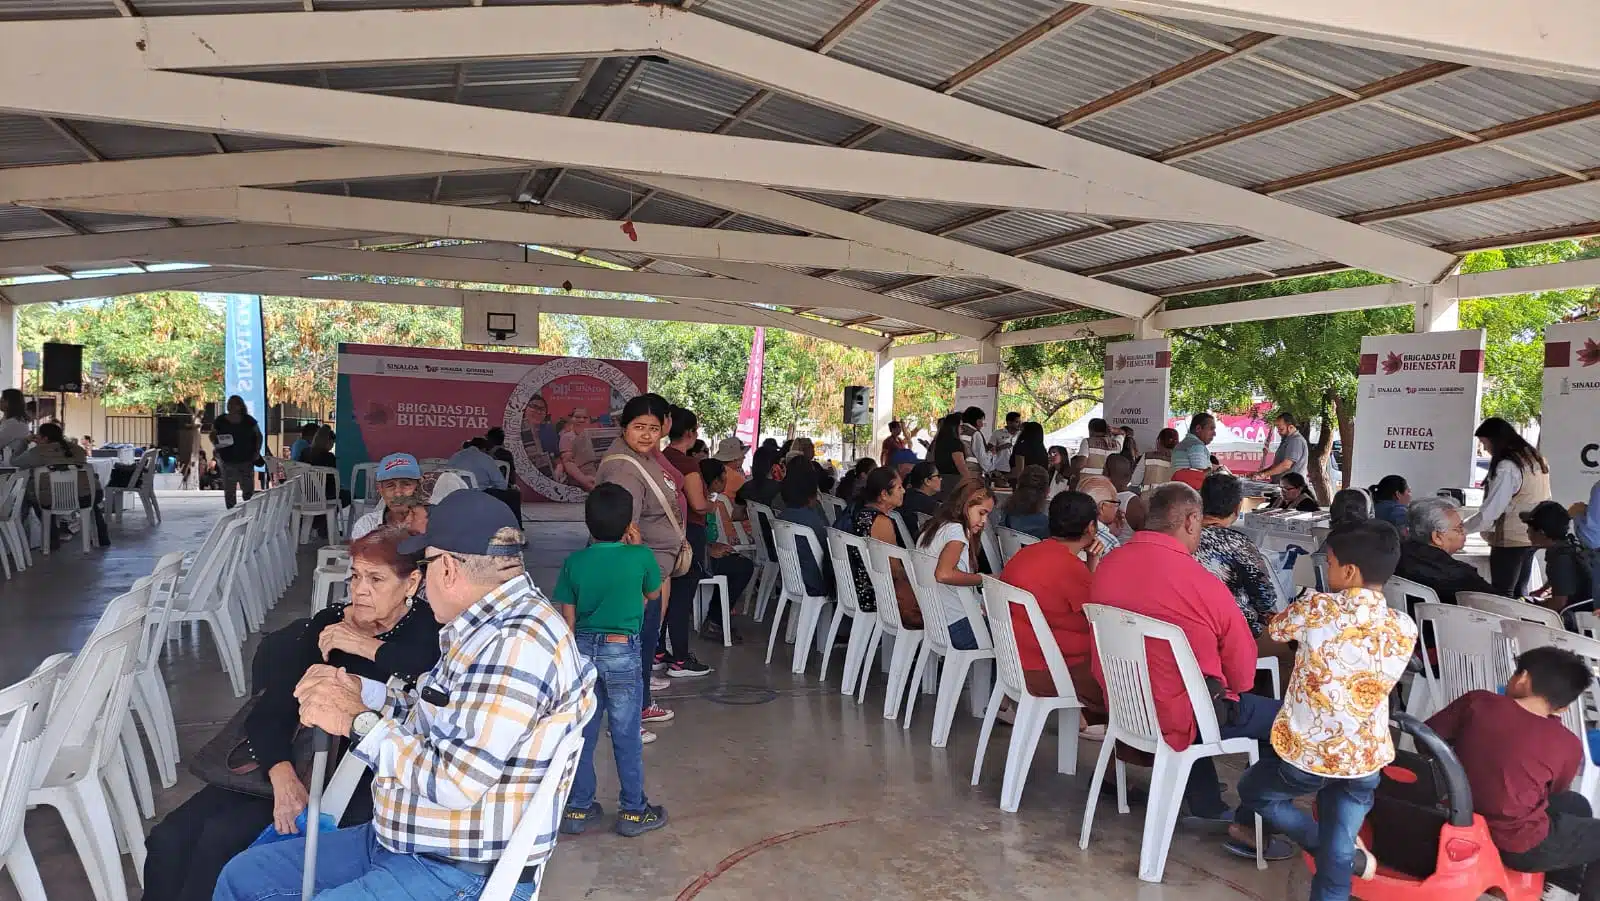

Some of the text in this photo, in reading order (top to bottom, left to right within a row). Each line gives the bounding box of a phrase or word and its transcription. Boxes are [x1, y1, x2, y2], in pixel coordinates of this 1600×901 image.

[1403, 352, 1457, 362] BRIGADAS DEL
[386, 362, 419, 371] SINALOA
[1403, 361, 1456, 371] BIENESTAR
[397, 402, 489, 416] BRIGADAS DEL
[1120, 407, 1142, 415] APOYOS
[396, 413, 489, 429] BIENESTAR
[1112, 417, 1149, 425] FUNCIONALES
[1387, 427, 1433, 437] ENTREGA
[1383, 439, 1435, 451] DE LENTES
